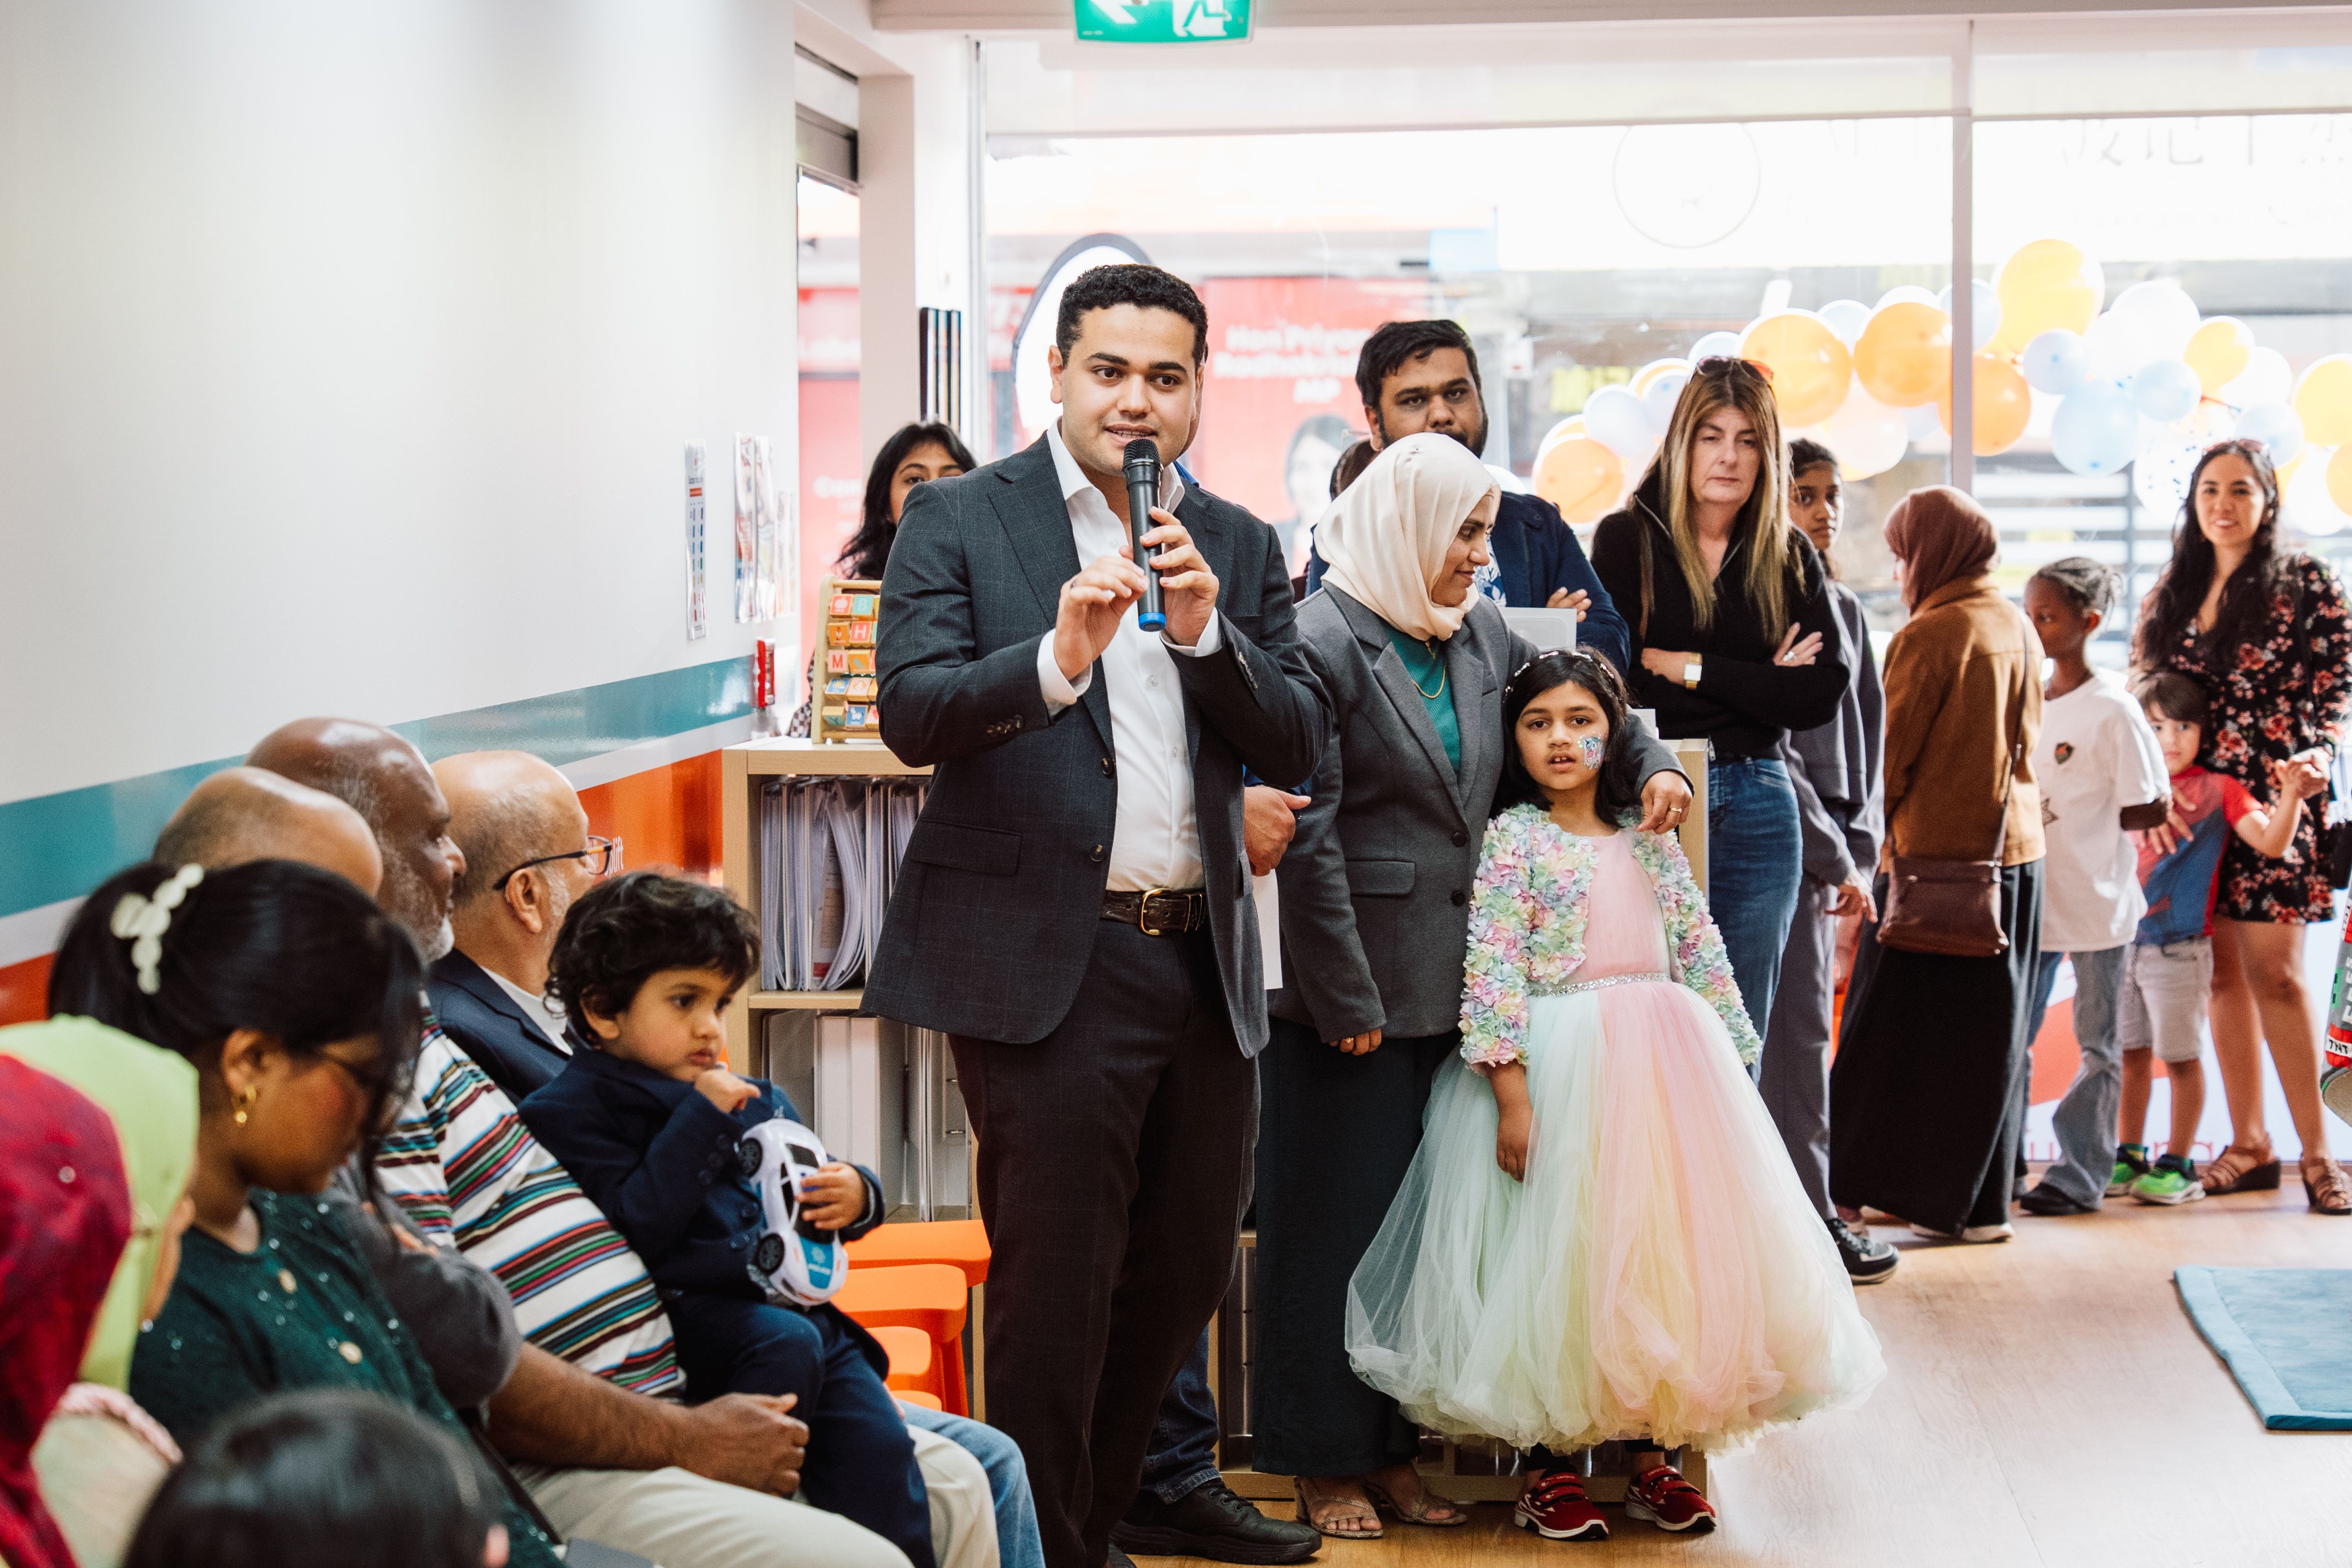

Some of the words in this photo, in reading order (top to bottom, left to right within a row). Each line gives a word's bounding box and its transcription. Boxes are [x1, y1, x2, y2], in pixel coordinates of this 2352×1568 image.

[857, 598, 867, 611] B
[854, 625, 867, 639] H
[832, 654, 843, 668] M
[2329, 1039, 2348, 1055] TNT
